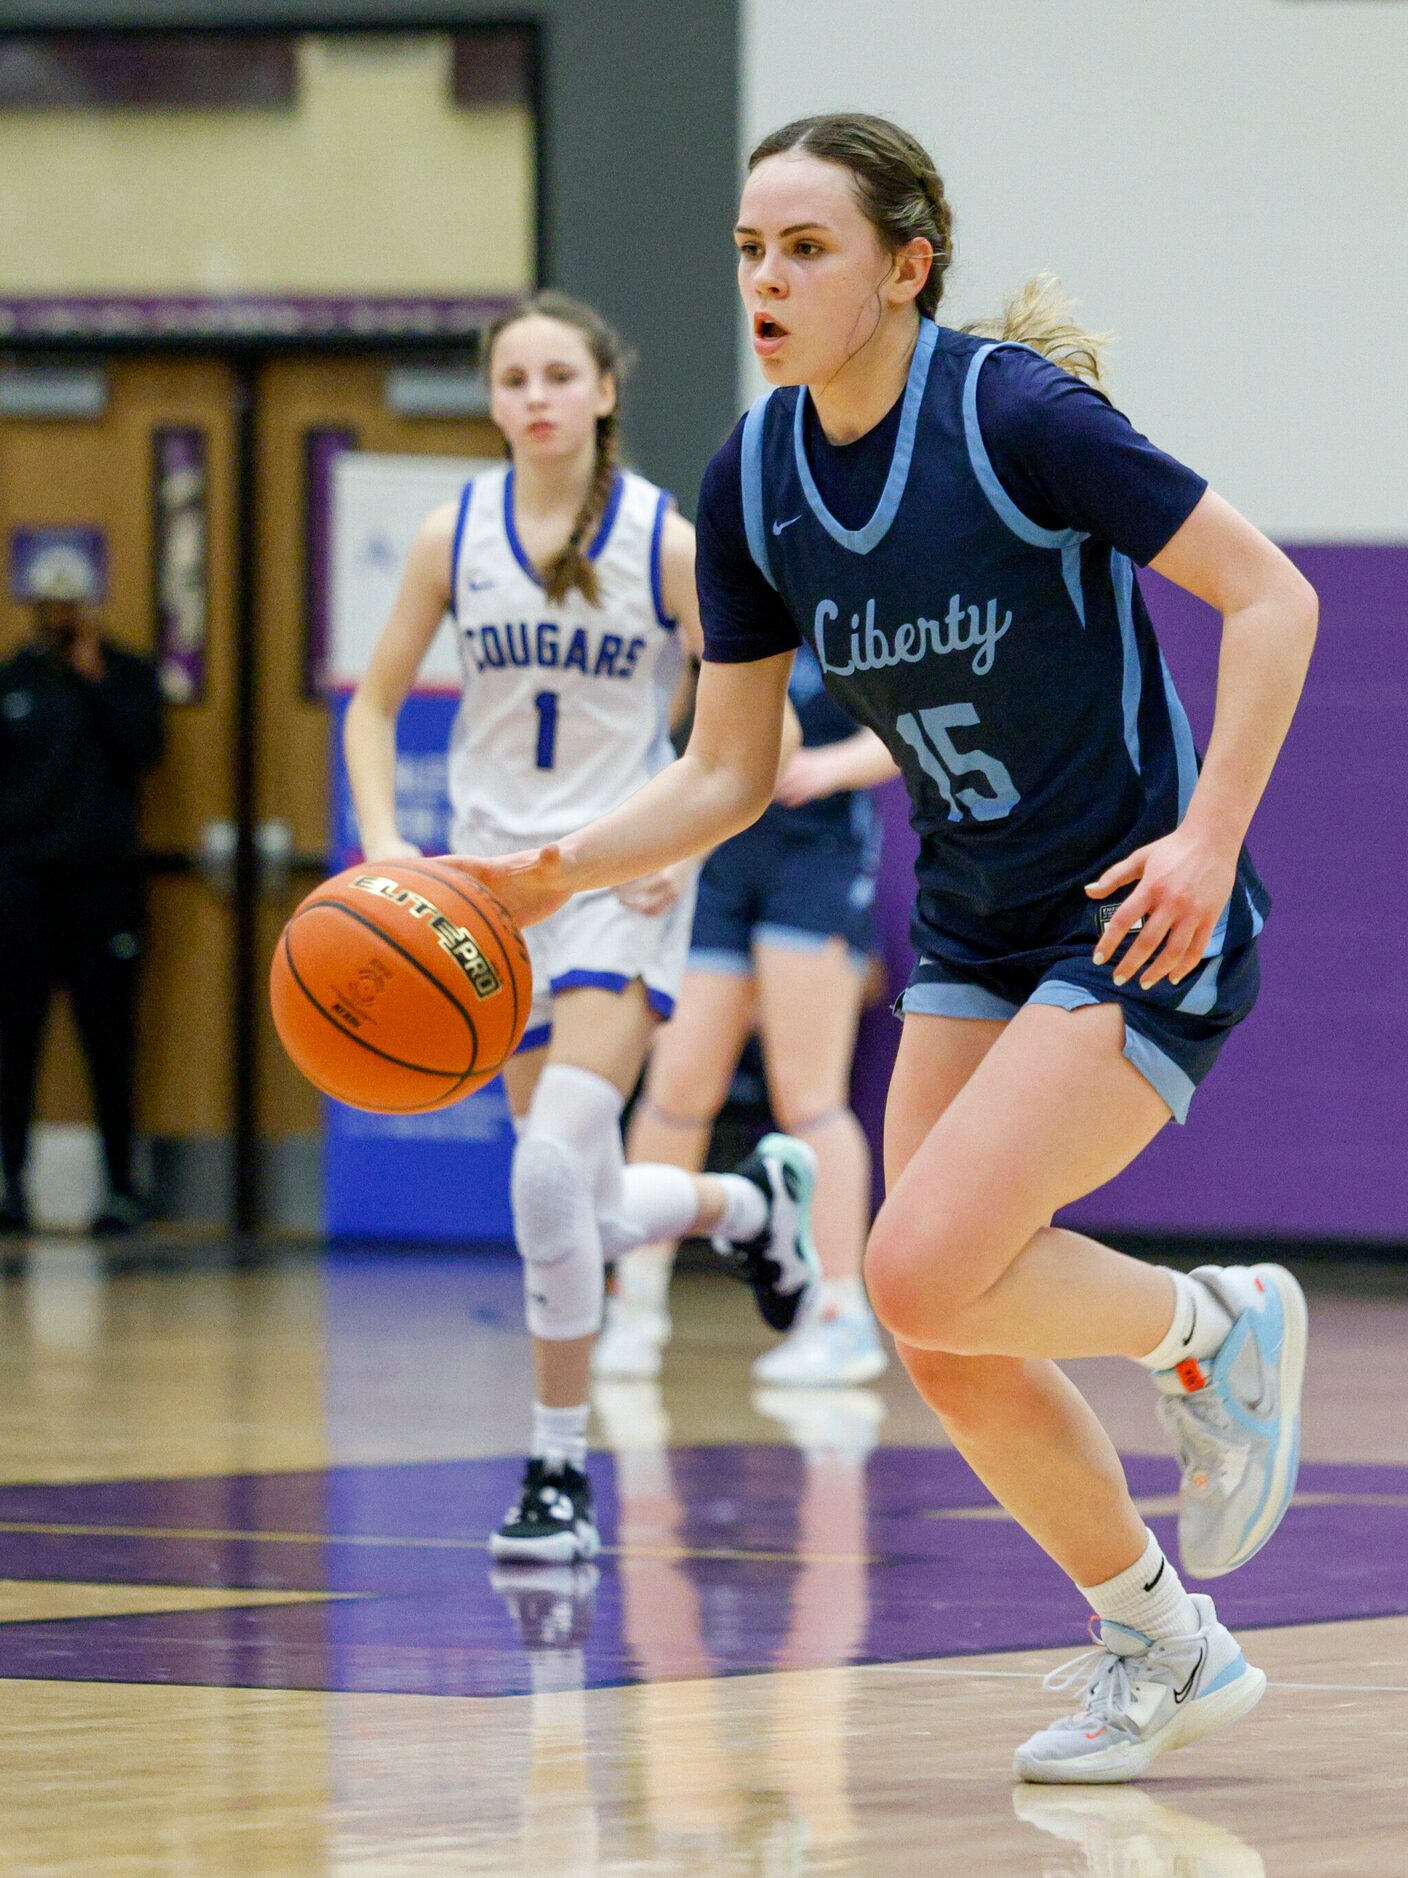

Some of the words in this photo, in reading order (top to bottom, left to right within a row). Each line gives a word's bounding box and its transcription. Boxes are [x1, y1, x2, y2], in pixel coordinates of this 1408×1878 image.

[814, 593, 1013, 677] Liberty
[533, 690, 560, 770] 1
[896, 702, 1022, 823] 15
[350, 875, 464, 949] ELITE
[449, 935, 502, 1000] PRO
